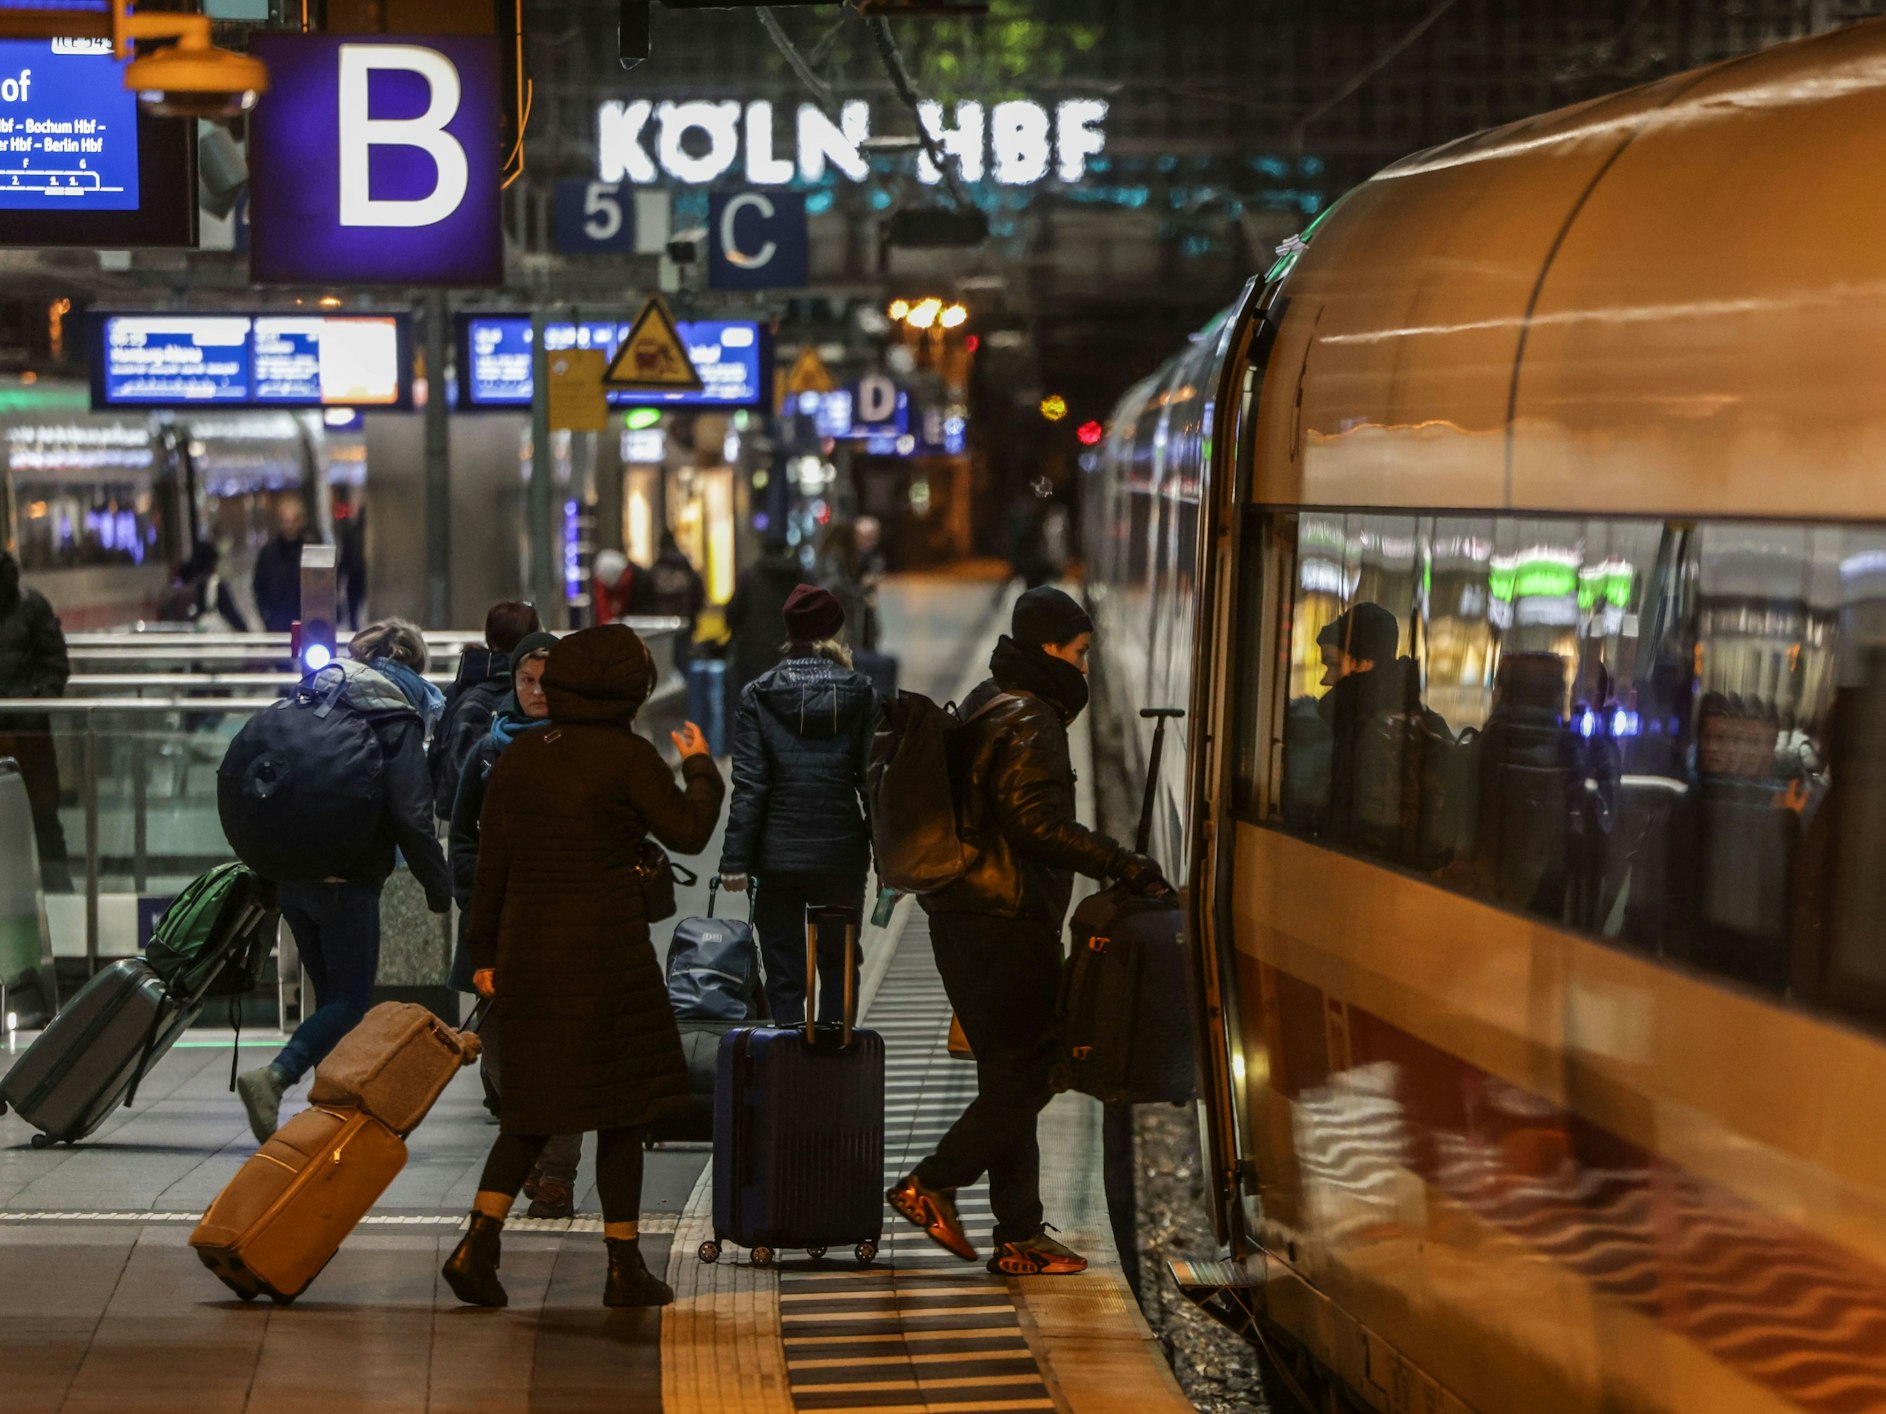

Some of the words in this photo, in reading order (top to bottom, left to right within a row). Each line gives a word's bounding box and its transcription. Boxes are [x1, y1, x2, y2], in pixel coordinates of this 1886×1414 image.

[1, 69, 31, 102] of
[10, 136, 32, 152] Hbf
[44, 137, 80, 153] Berlin
[81, 137, 104, 153] Hbf
[25, 118, 73, 134] Bochum
[74, 119, 97, 134] Hbf
[338, 43, 468, 227] B
[600, 99, 870, 184] KÖLN
[917, 98, 1109, 184] HBF
[584, 183, 622, 240] 5
[720, 192, 777, 269] C
[859, 374, 896, 422] D
